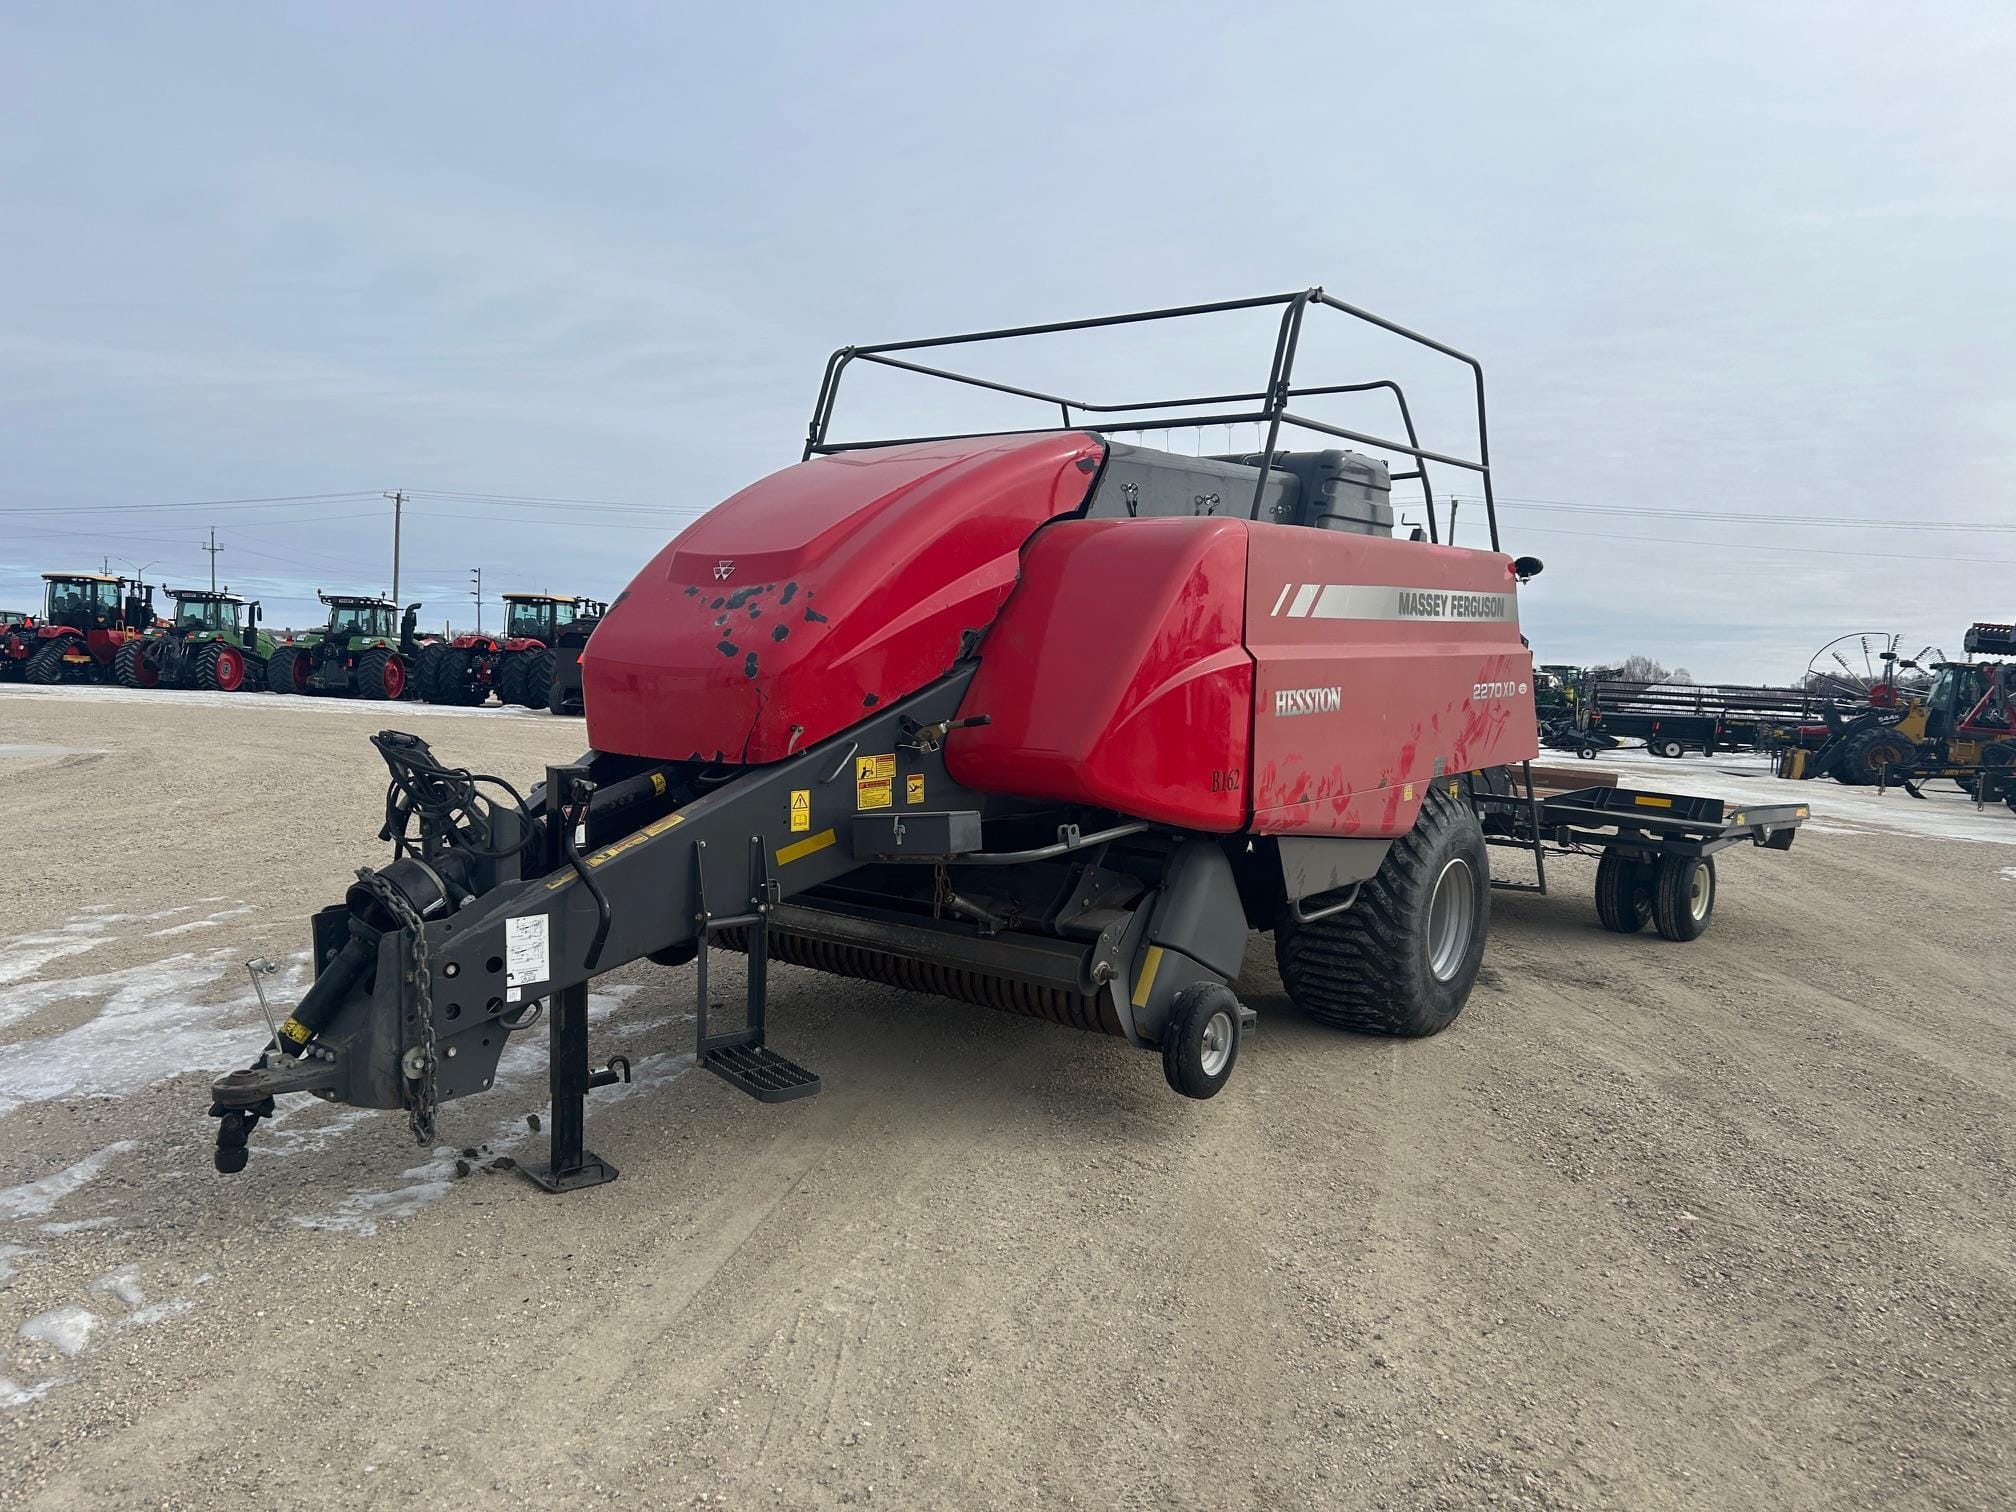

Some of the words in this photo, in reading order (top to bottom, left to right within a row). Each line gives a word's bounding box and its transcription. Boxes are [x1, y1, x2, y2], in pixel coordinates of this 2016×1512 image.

[1398, 592, 1448, 616] MASSEY
[1450, 595, 1504, 617] FERGUSON
[1275, 687, 1342, 717] HESSTON
[1211, 769, 1240, 792] B162
